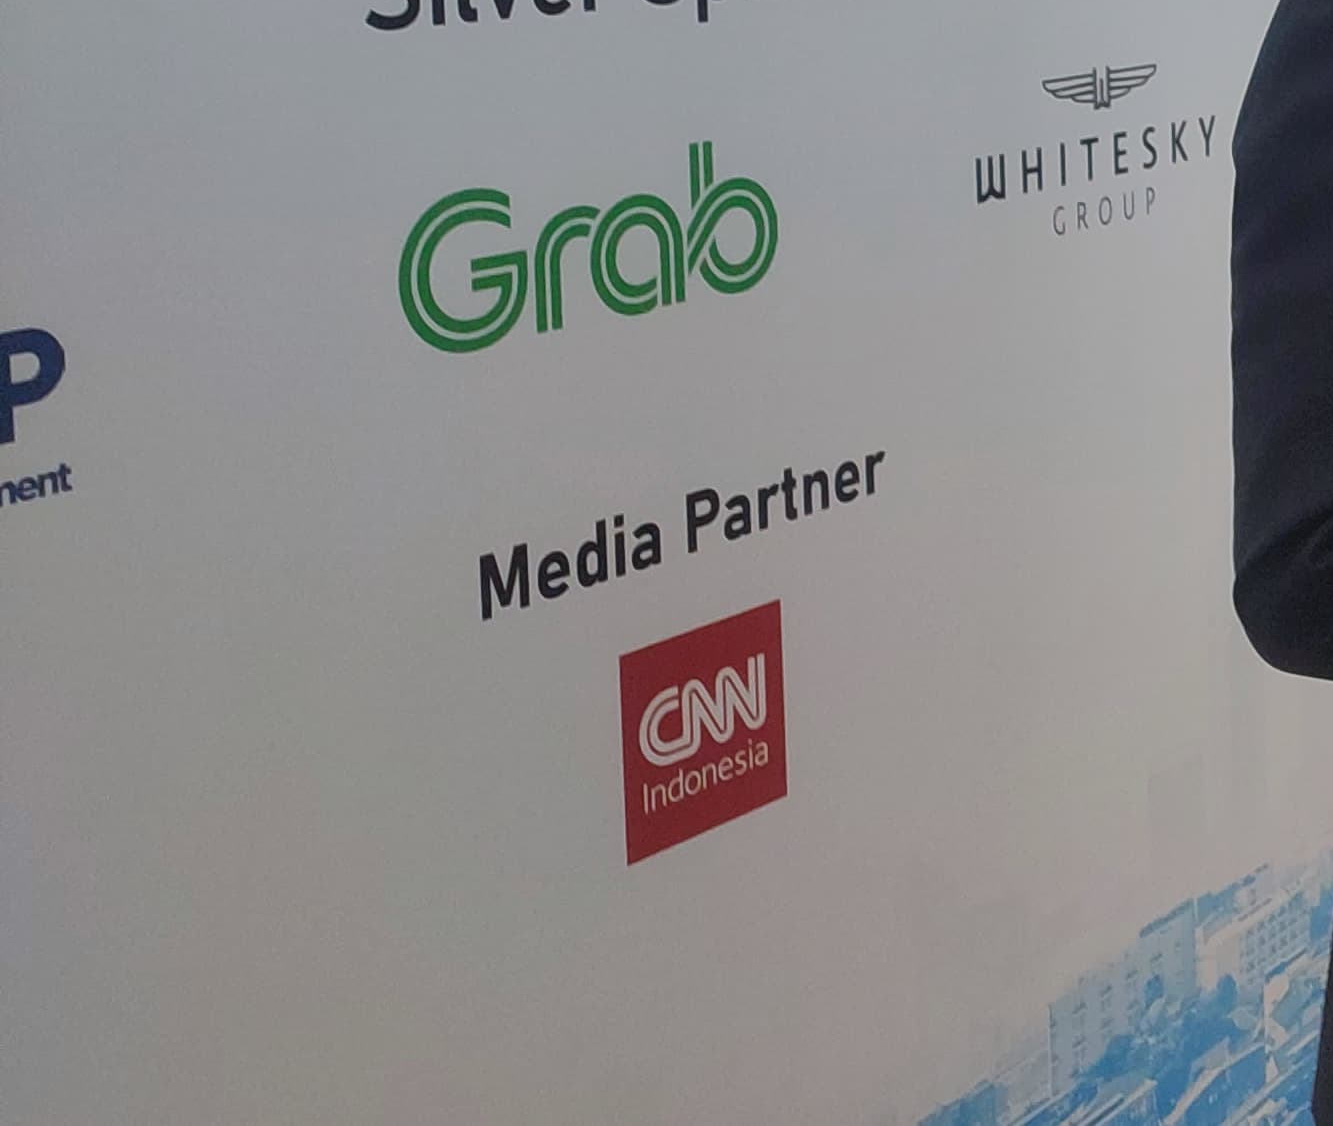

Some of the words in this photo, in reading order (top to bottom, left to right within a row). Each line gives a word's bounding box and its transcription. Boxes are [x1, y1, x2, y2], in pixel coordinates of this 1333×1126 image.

[976, 116, 1214, 204] WHITESKY
[399, 141, 778, 353] Grab
[1053, 187, 1155, 236] GROUP
[480, 514, 661, 620] Media
[686, 450, 886, 554] Partner
[638, 653, 767, 767] CNN
[642, 738, 770, 816] Indonesia
